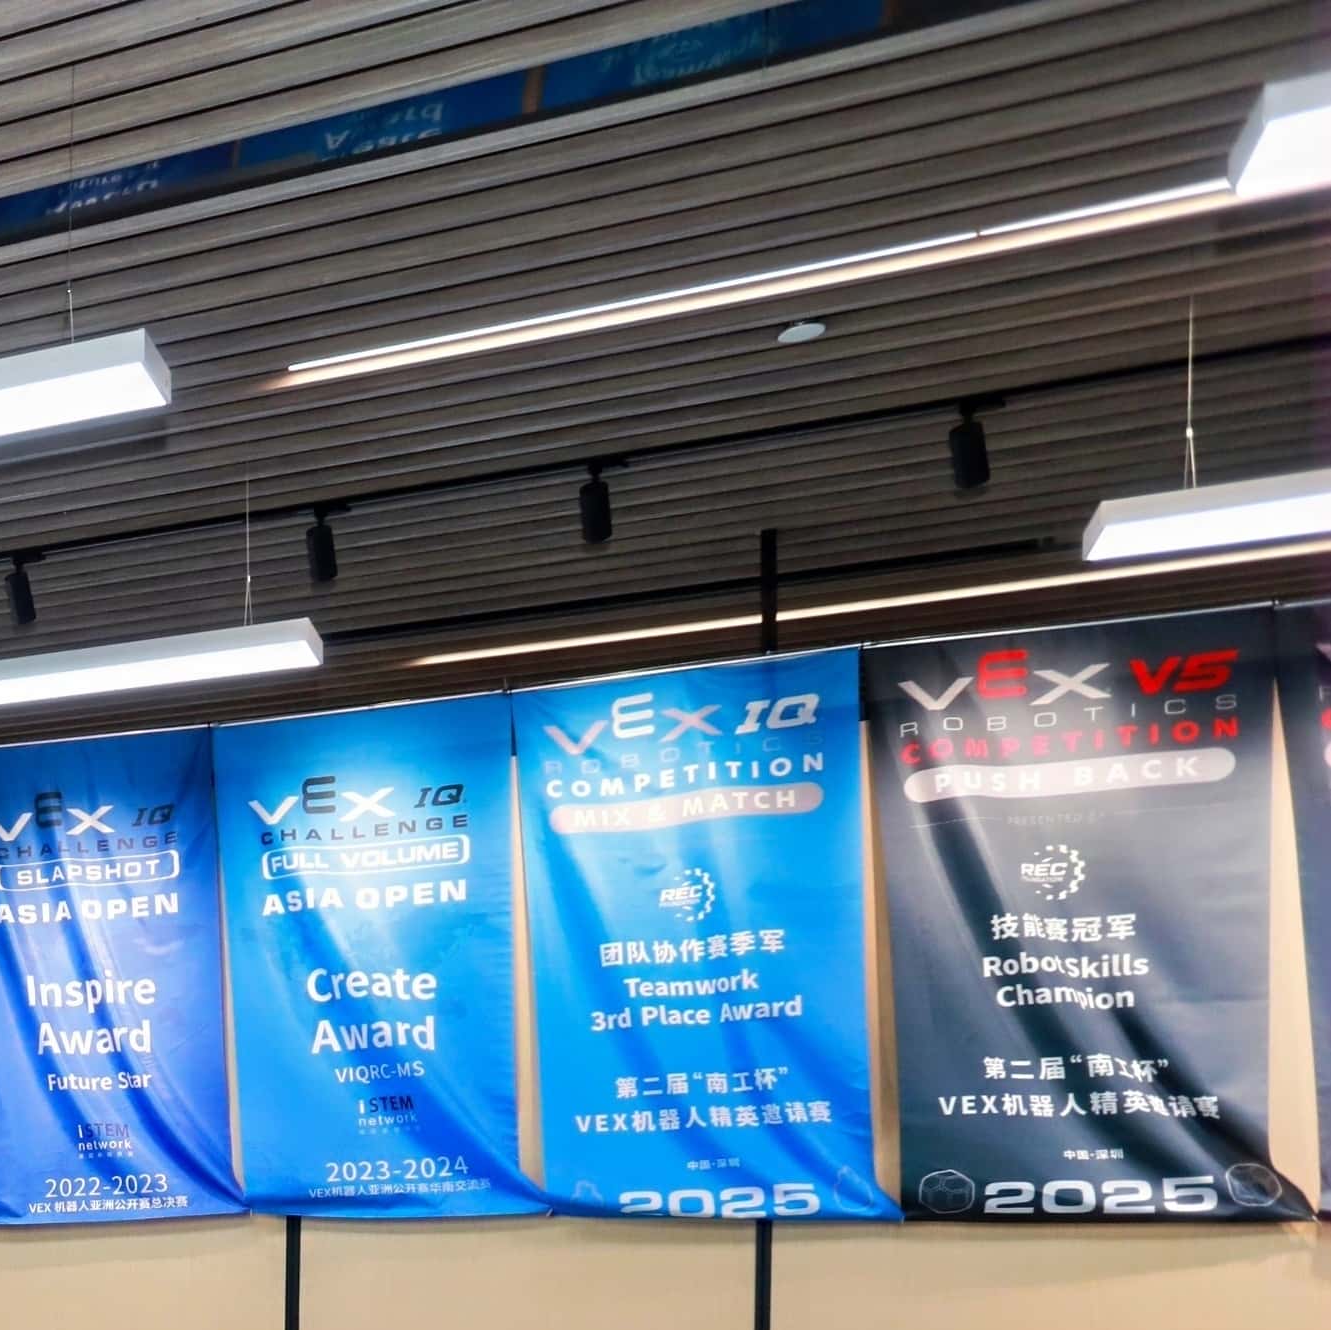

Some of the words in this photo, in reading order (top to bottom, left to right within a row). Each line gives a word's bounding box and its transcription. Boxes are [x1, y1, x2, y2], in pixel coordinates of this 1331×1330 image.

[898, 649, 1111, 711] VEX
[1130, 649, 1238, 694] V5
[543, 693, 722, 756] VEX
[735, 693, 820, 735] IQ
[899, 694, 1237, 738] ROBOTICS
[545, 731, 824, 775] ROBOTICS
[900, 717, 1238, 765] COMPETITION
[546, 752, 824, 798] COMPETITION
[934, 770, 1040, 793] PUSH
[1075, 756, 1202, 786] BACK
[132, 803, 174, 827] IQ
[248, 776, 396, 825] VEX
[413, 784, 464, 808] IQ
[572, 808, 632, 829] MIX
[682, 790, 796, 817] MATCH
[261, 814, 468, 846] CHALLENGE
[17, 859, 161, 887] SLAPSHOT
[271, 853, 330, 874] FULL
[341, 842, 459, 868] VOLUME
[1021, 861, 1068, 876] REC
[81, 893, 179, 920] OPEN
[262, 888, 344, 916] ASIA
[355, 880, 467, 910] OPEN
[660, 886, 703, 902] REC
[991, 913, 1136, 943] 技能赛冠军
[600, 929, 784, 967] 团队协作赛季军
[983, 952, 1149, 979] RobotSkills
[26, 970, 156, 1014] Inspire
[306, 968, 437, 1002] Create
[623, 969, 758, 998] Teamwork
[997, 984, 1136, 1011] Champion
[590, 1008, 632, 1032] 3rd
[641, 1003, 711, 1027] Place
[720, 995, 802, 1024] Award
[38, 1020, 152, 1055] Award
[311, 1016, 435, 1054] Award
[48, 1073, 112, 1092] Future
[118, 1071, 152, 1089] Star
[335, 1060, 425, 1083] VIQRC-MS
[358, 1113, 418, 1127] network
[576, 1100, 832, 1133] VEX机器人精英邀请赛
[78, 1140, 132, 1151] network
[326, 1155, 468, 1182] 2023-2024
[45, 1174, 168, 1198] 2022-2023
[619, 1183, 821, 1218] 2025
[983, 1175, 1219, 1214] 2025
